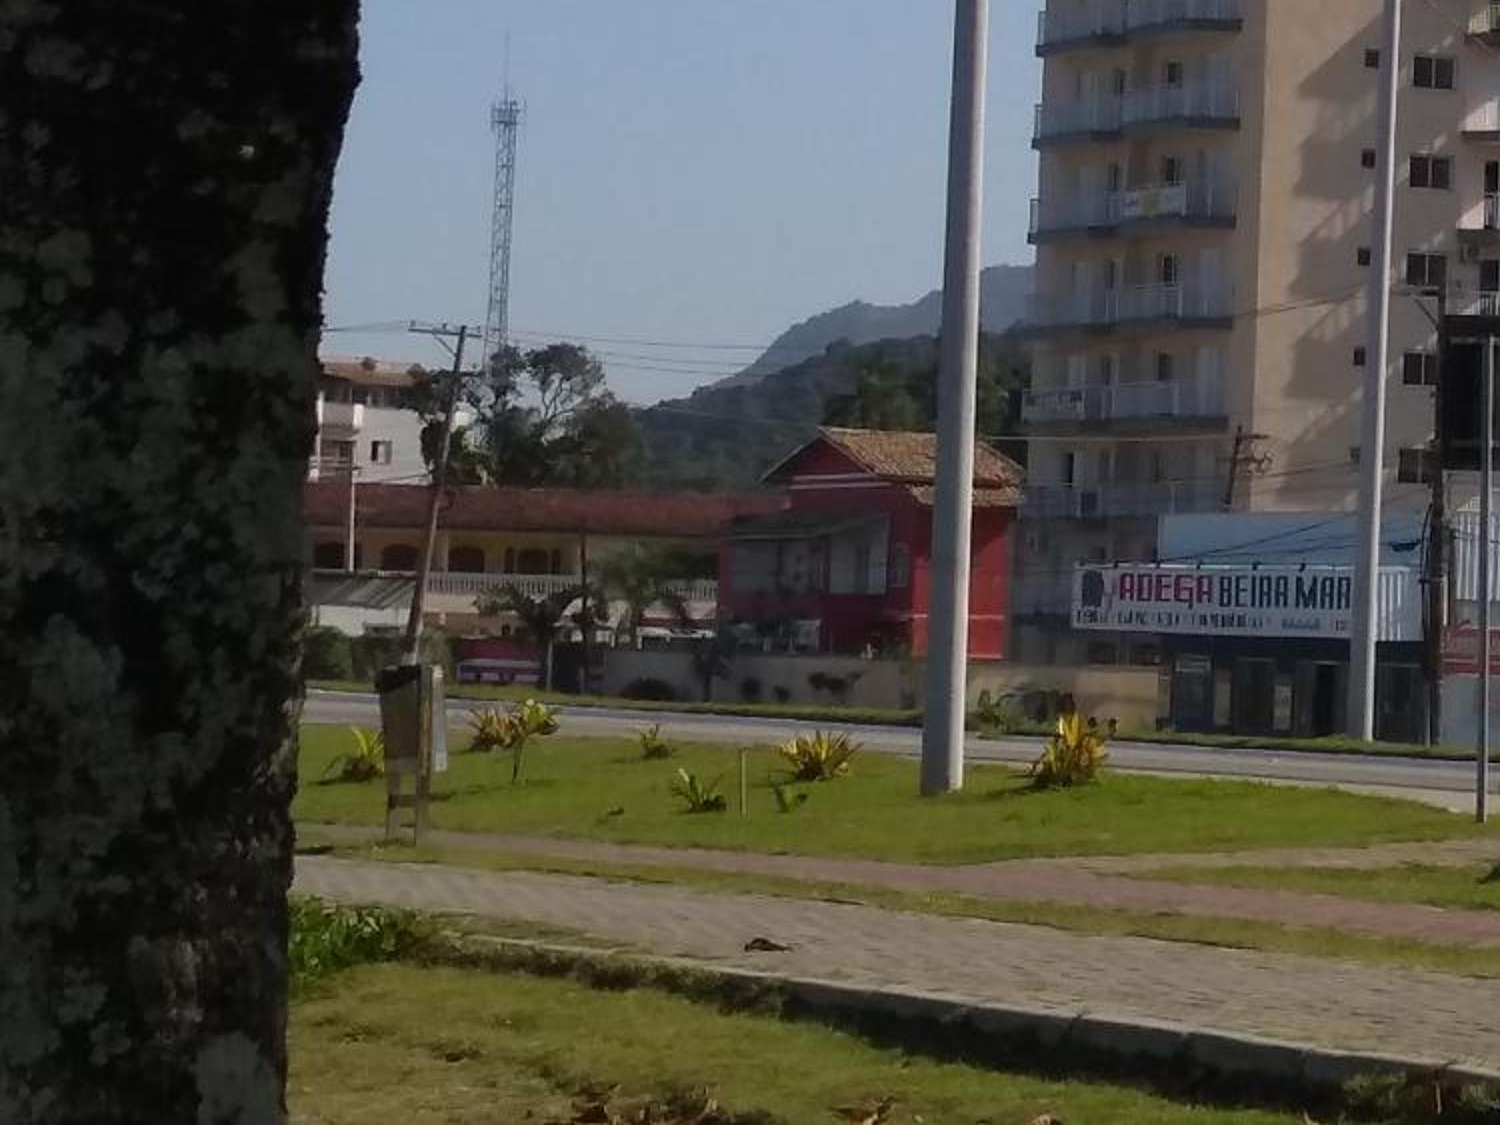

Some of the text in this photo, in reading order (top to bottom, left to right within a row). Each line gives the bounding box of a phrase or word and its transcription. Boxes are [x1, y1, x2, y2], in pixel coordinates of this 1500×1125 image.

[1119, 573, 1351, 609] ADEGA BEIRA MAR
